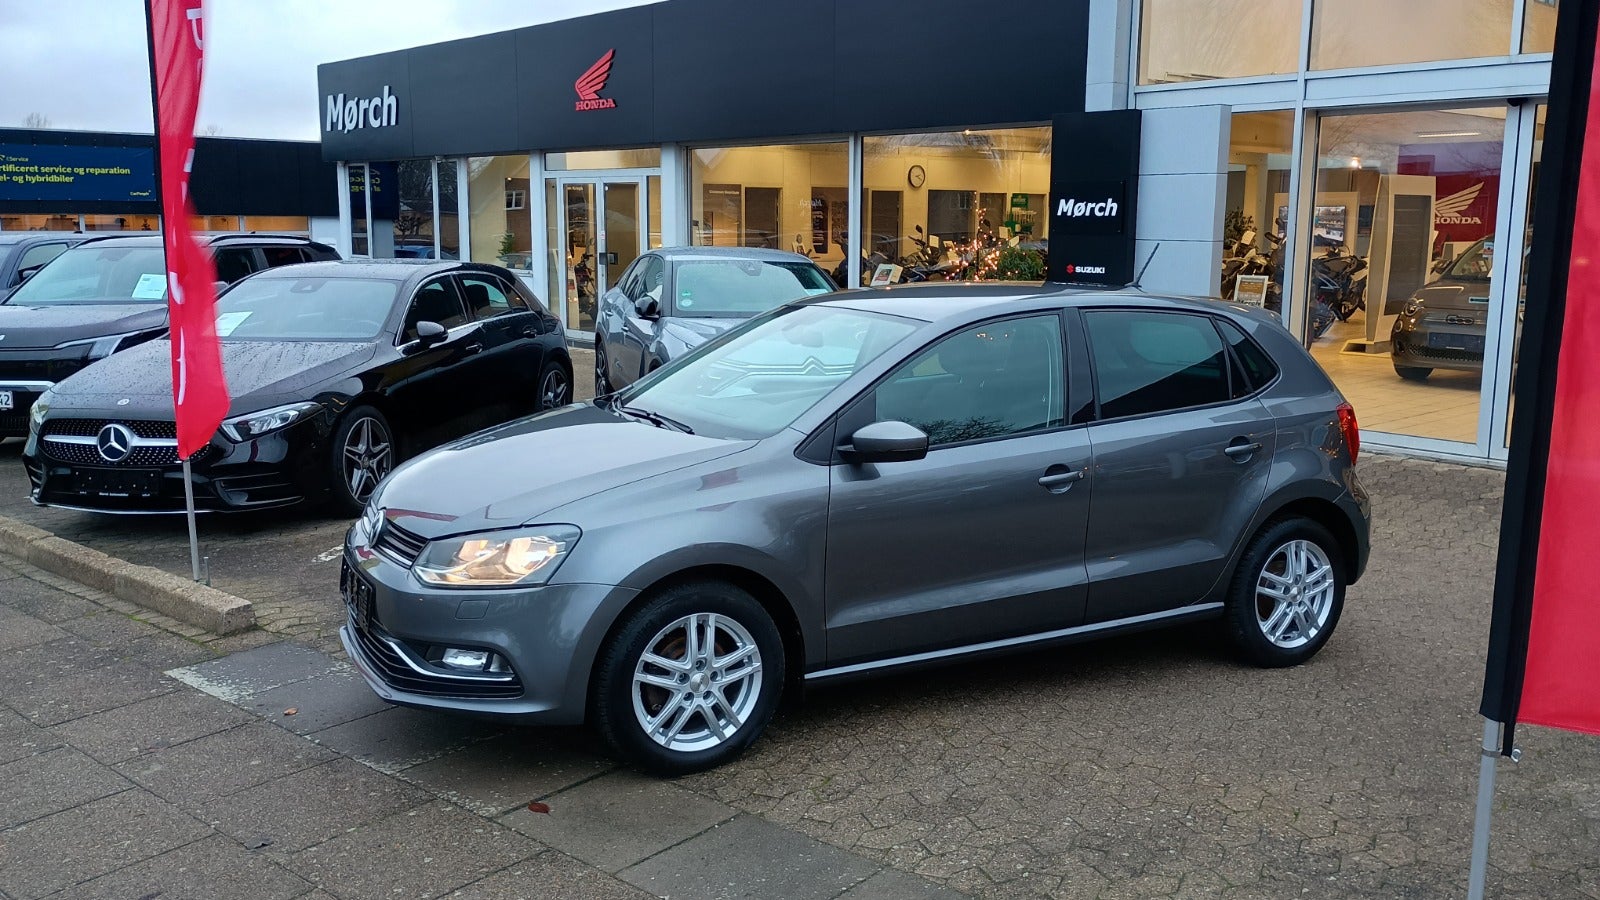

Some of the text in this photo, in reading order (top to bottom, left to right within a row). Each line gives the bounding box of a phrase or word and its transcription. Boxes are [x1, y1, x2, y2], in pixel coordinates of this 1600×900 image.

[326, 85, 397, 134] Mørch
[575, 98, 616, 111] HONDA
[40, 165, 72, 173] service
[73, 167, 85, 176] og
[86, 166, 131, 176] reparation
[12, 175, 24, 184] og
[25, 174, 74, 184] hybridbiler
[1056, 198, 1118, 218] Mørch
[1075, 266, 1105, 274] SUZUKI
